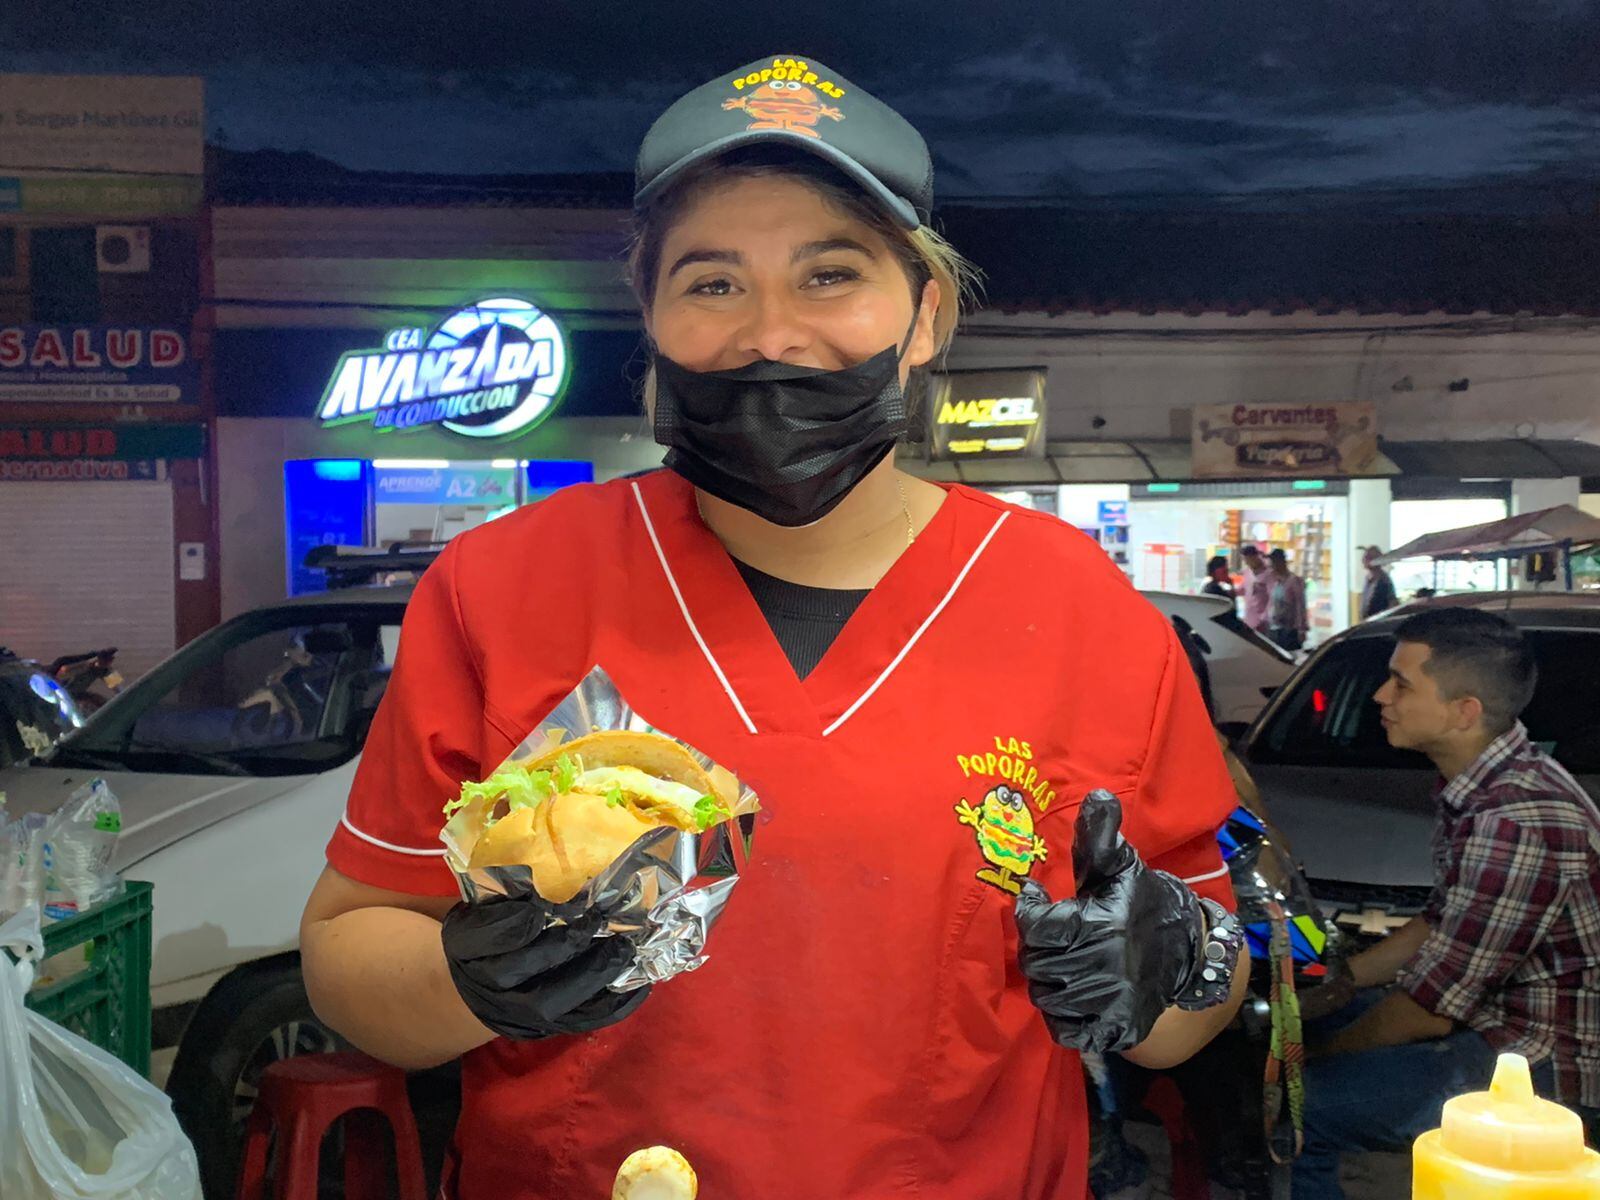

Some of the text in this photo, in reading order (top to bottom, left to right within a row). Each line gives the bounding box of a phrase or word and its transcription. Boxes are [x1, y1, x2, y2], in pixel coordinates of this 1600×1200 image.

[773, 58, 809, 71] LAS
[732, 66, 846, 99] POPORRAS
[0, 329, 184, 368] SALUD
[386, 328, 422, 350] CEA
[320, 322, 553, 419] AVANZADA
[375, 383, 519, 428] DE CONDUCCION
[1232, 404, 1338, 430] Cervantes
[445, 478, 476, 498] A2
[993, 735, 1033, 760] LAS
[956, 752, 1057, 812] POPORRAS
